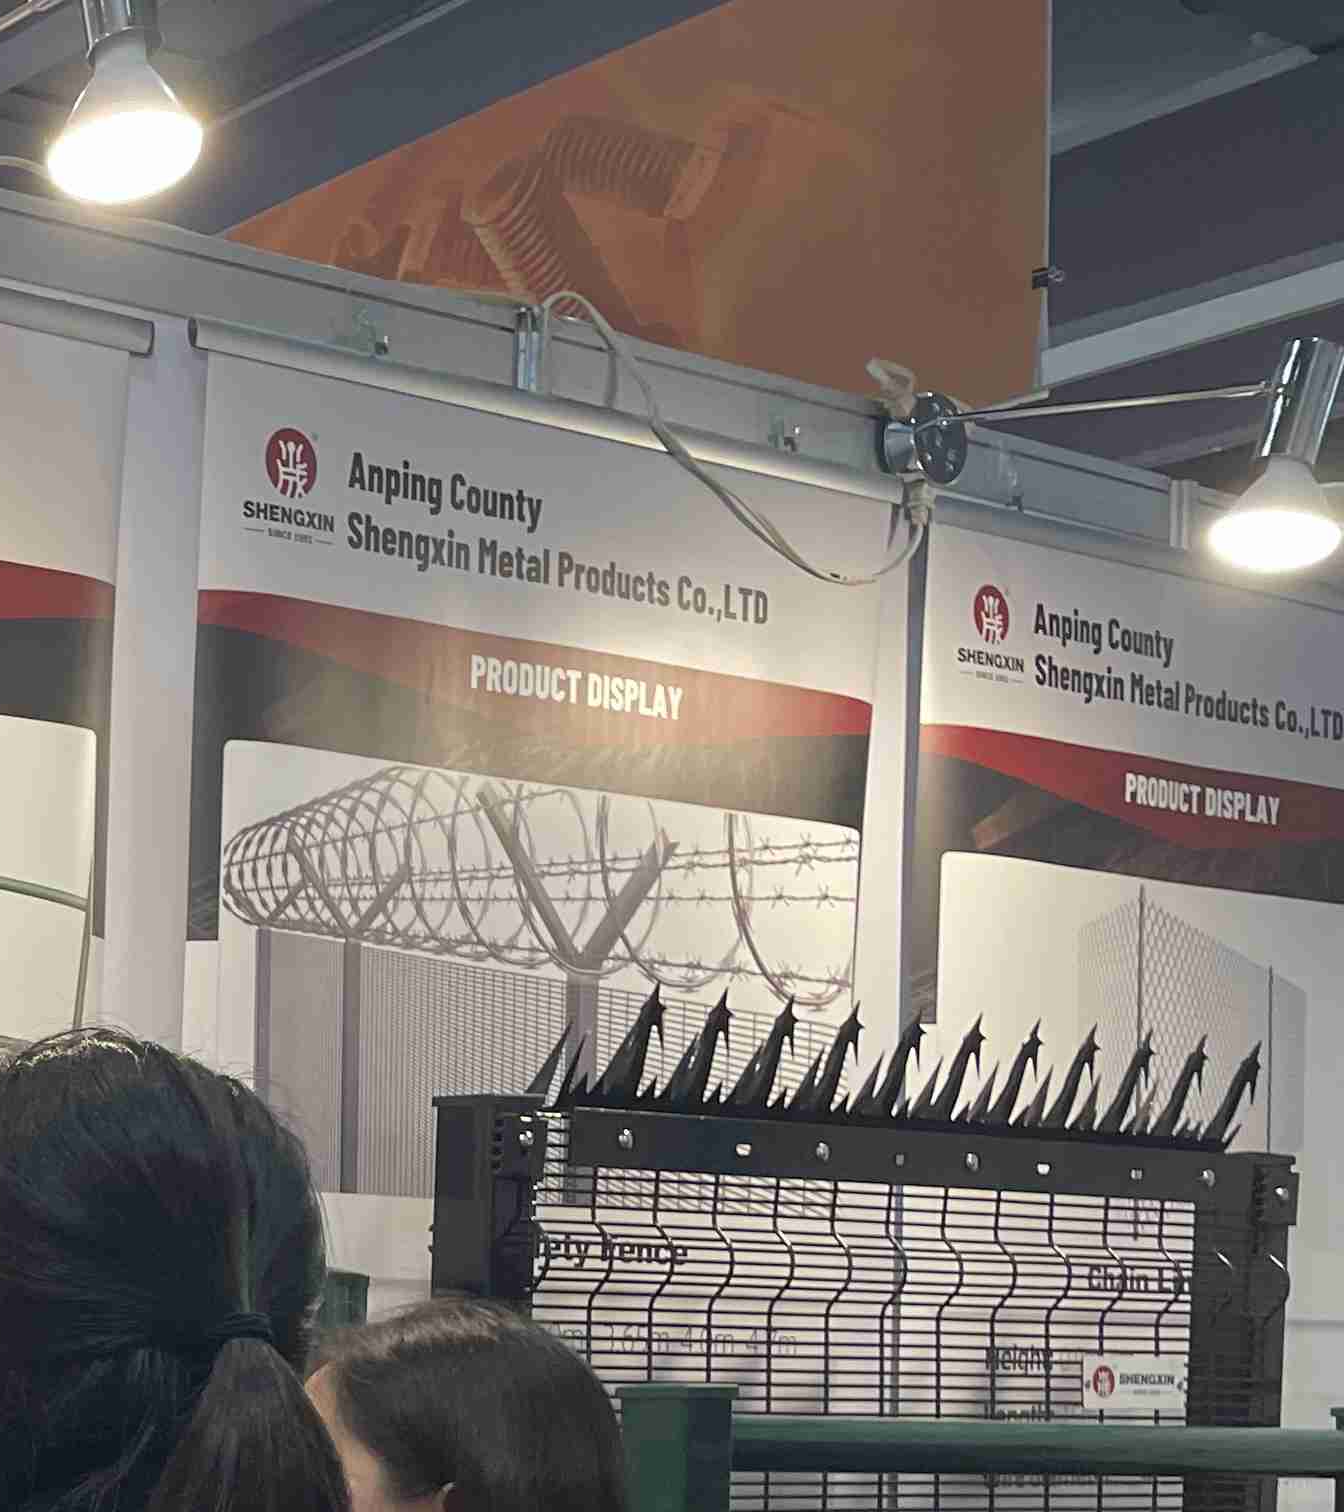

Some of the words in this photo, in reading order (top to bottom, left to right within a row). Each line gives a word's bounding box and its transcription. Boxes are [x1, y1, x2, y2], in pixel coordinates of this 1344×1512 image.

[243, 500, 334, 532] SHENGXIN
[348, 452, 442, 515] Anping
[450, 472, 542, 533] County
[347, 512, 470, 572] Shengxin
[478, 537, 550, 585] Metal
[558, 551, 670, 607] Products
[677, 575, 768, 624] Co.,LTD
[1034, 603, 1102, 655] Anping
[1108, 618, 1174, 668] County
[471, 654, 582, 704] PRODUCT
[587, 672, 683, 720] DISPLAY
[1035, 653, 1124, 704] Shengxin
[1130, 672, 1180, 712] Metal
[1184, 682, 1269, 727] Products
[1275, 700, 1344, 740] Co.,LTD
[1125, 772, 1201, 815] PRODUCT
[1205, 788, 1280, 825] DISPLAY
